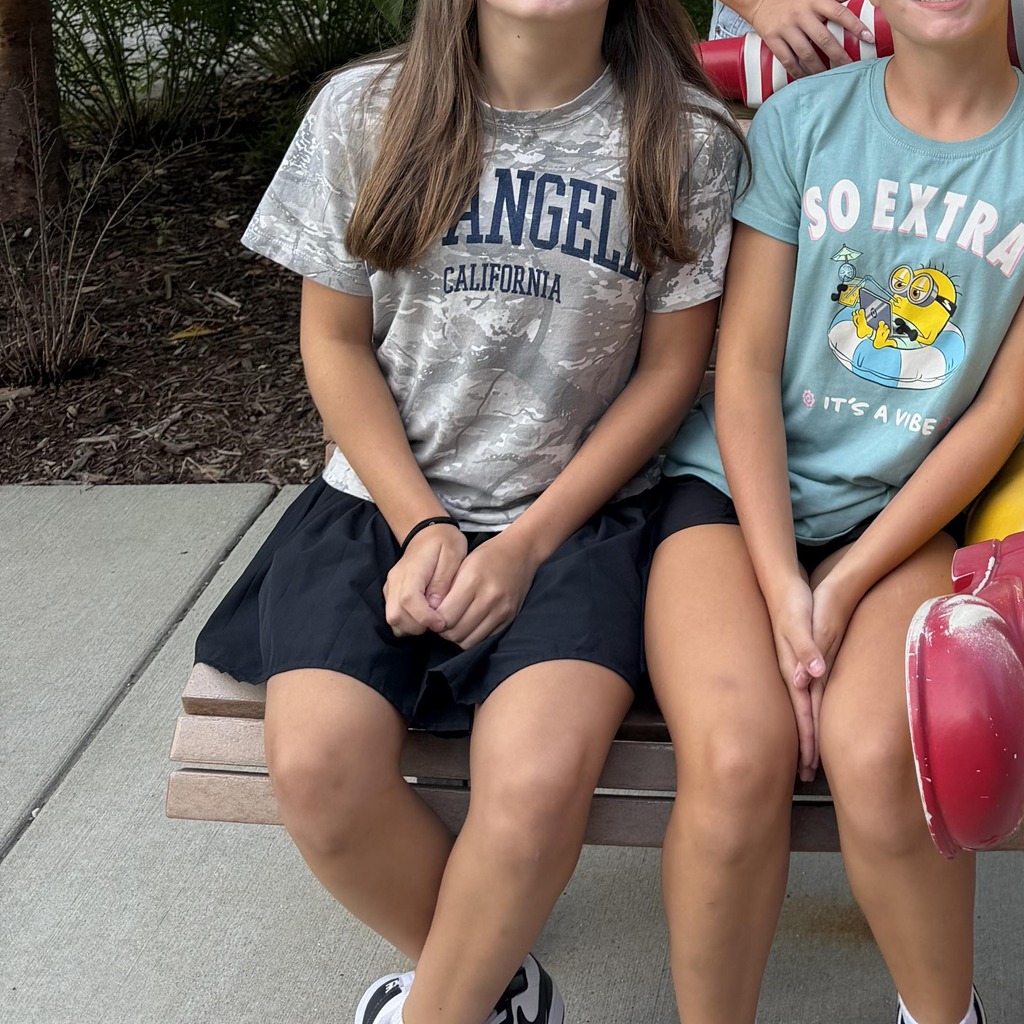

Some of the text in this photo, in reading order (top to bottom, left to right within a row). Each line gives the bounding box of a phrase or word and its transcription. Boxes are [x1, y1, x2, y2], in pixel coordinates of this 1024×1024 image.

[803, 178, 861, 241] SO
[443, 262, 562, 304] CALIFORNIA
[823, 396, 938, 437] IT'S A VIBE
